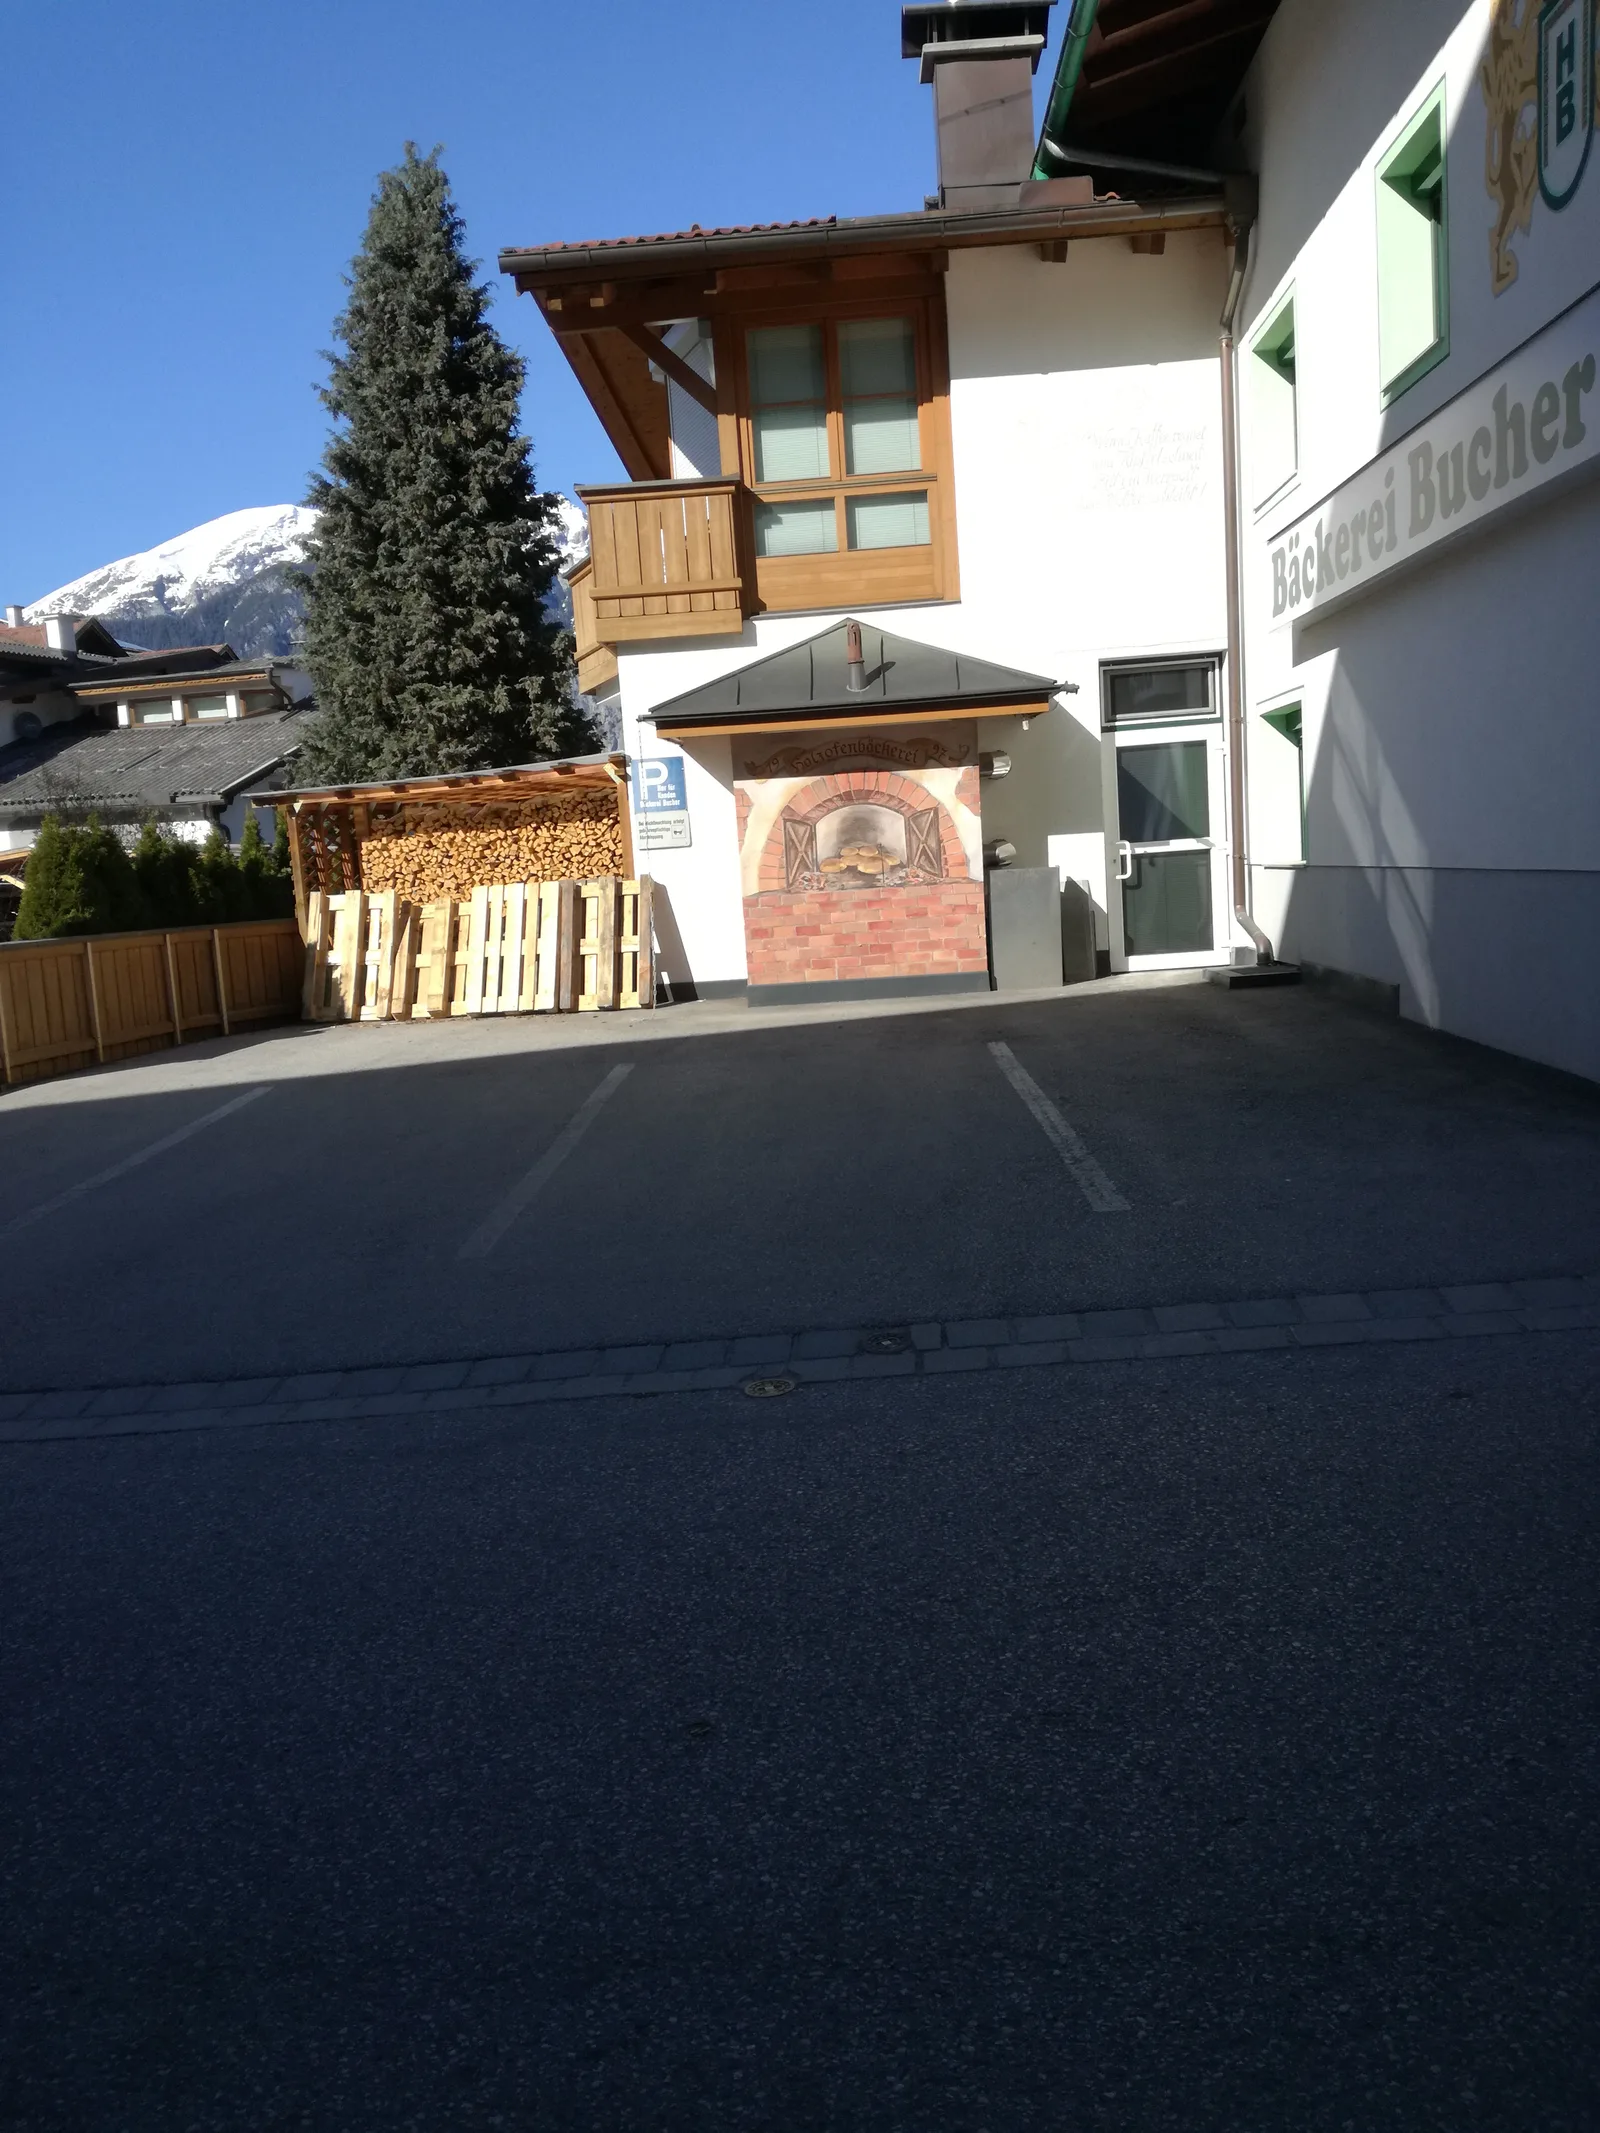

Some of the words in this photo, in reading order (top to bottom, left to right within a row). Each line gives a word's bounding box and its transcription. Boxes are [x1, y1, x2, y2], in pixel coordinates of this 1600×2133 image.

[1271, 466, 1398, 618] Bäckerei
[1407, 353, 1597, 540] Bucher
[791, 735, 920, 774] Holzofenbäckerei
[638, 761, 669, 800] P
